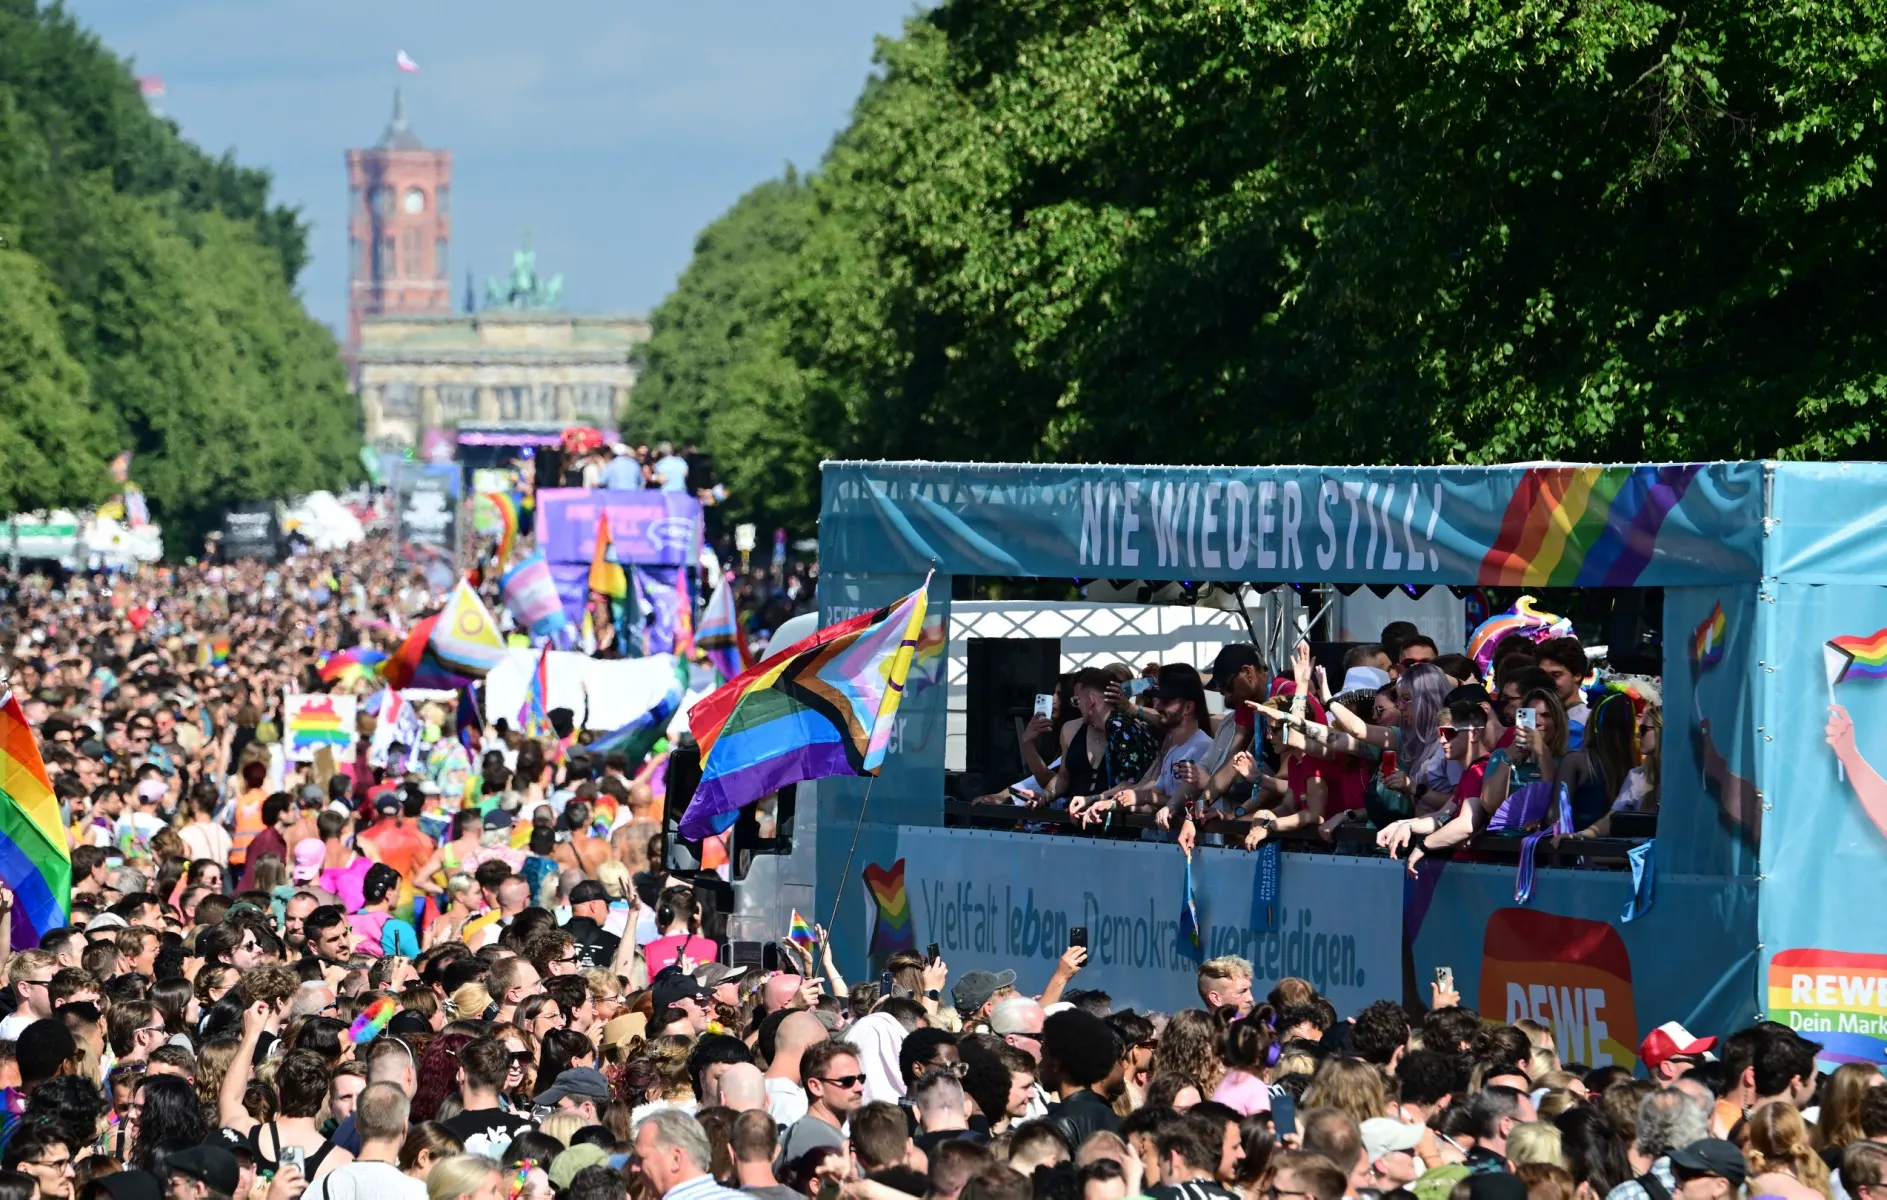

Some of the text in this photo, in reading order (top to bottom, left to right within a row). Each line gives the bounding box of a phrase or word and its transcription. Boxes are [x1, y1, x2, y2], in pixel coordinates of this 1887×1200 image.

[1080, 479, 1442, 572] NIE WIEDER STILL!
[922, 878, 998, 955] Vielfalt
[1083, 891, 1201, 972] Demokra
[1211, 906, 1366, 996] verteidigen.
[1789, 1010, 1887, 1035] Dein Mark
